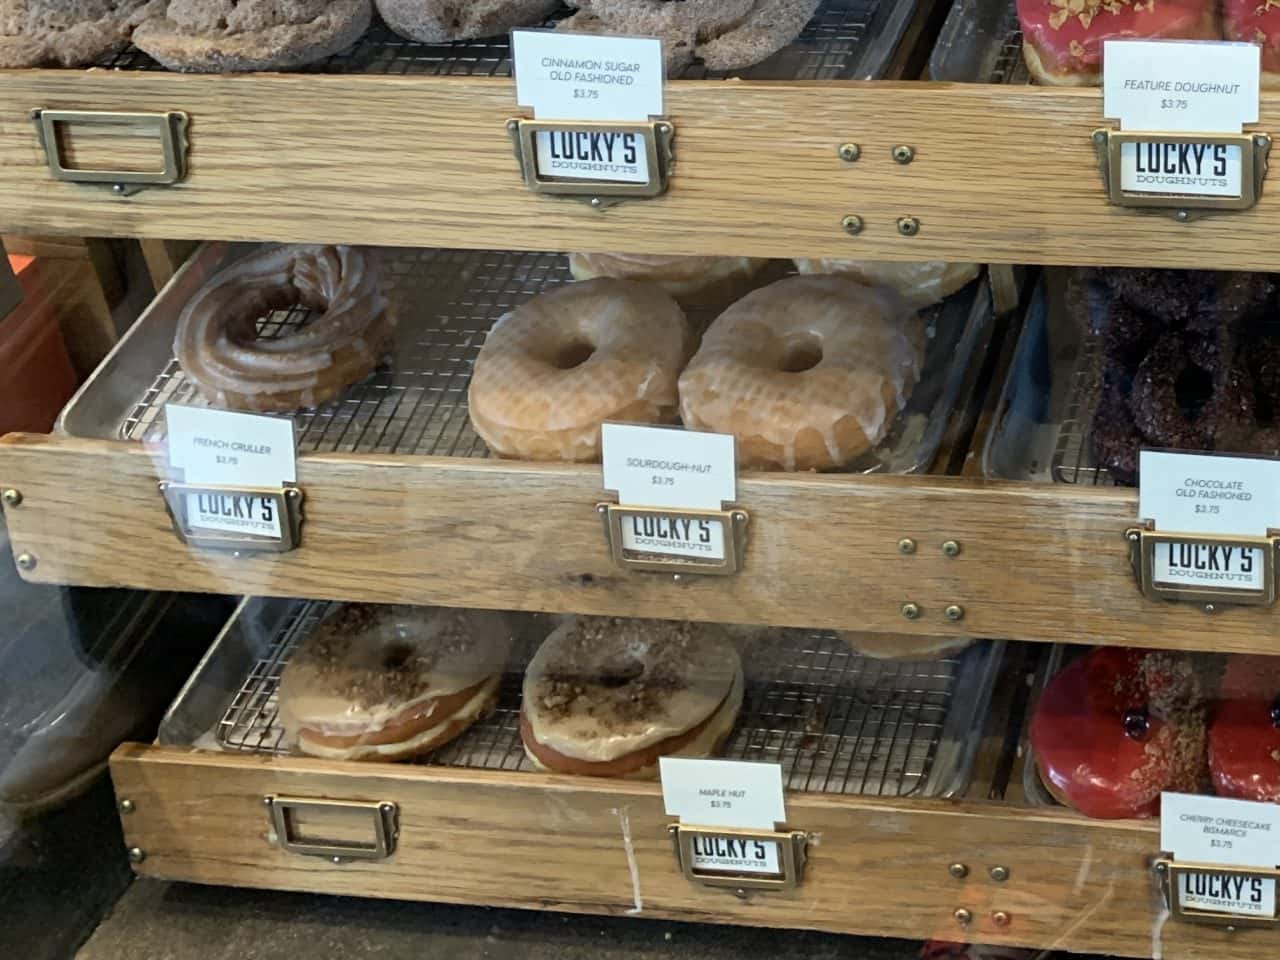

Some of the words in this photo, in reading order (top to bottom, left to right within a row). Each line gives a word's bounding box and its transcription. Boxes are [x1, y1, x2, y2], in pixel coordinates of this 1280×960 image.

[541, 57, 602, 71] CINNAMON
[604, 61, 640, 73] SUGAR
[550, 70, 572, 81] OLD
[574, 73, 634, 86] FASHIONED
[573, 89, 599, 99] $3.75
[1124, 79, 1171, 91] FEATURE
[1174, 82, 1240, 94] DOUGHNUT
[1161, 99, 1188, 109] $3.75
[550, 132, 636, 164] LUCKY'S
[551, 160, 637, 174] DOUGHNUTS
[1136, 143, 1226, 176] LUCKY'S
[1136, 175, 1228, 187] DOUGHNUTS
[193, 437, 229, 449] FRENCH
[231, 442, 271, 454] CRULLER
[626, 457, 712, 473] SOURDOUGH-NUT
[652, 476, 674, 486] $3.75
[1184, 478, 1243, 490] CHOCOLATE
[1176, 488, 1196, 498] OLD
[1198, 490, 1252, 501] FASHIONED
[199, 494, 273, 522] LUCKYS
[633, 516, 711, 543] LUCKYS
[1169, 543, 1252, 572] LUCKYS
[1168, 568, 1252, 581] DOUGHNUTS
[699, 789, 726, 798] MAPLE
[1179, 814, 1214, 824] CHERRY
[1216, 817, 1272, 831] CHEESECAKE
[693, 836, 765, 860] LUCKYS
